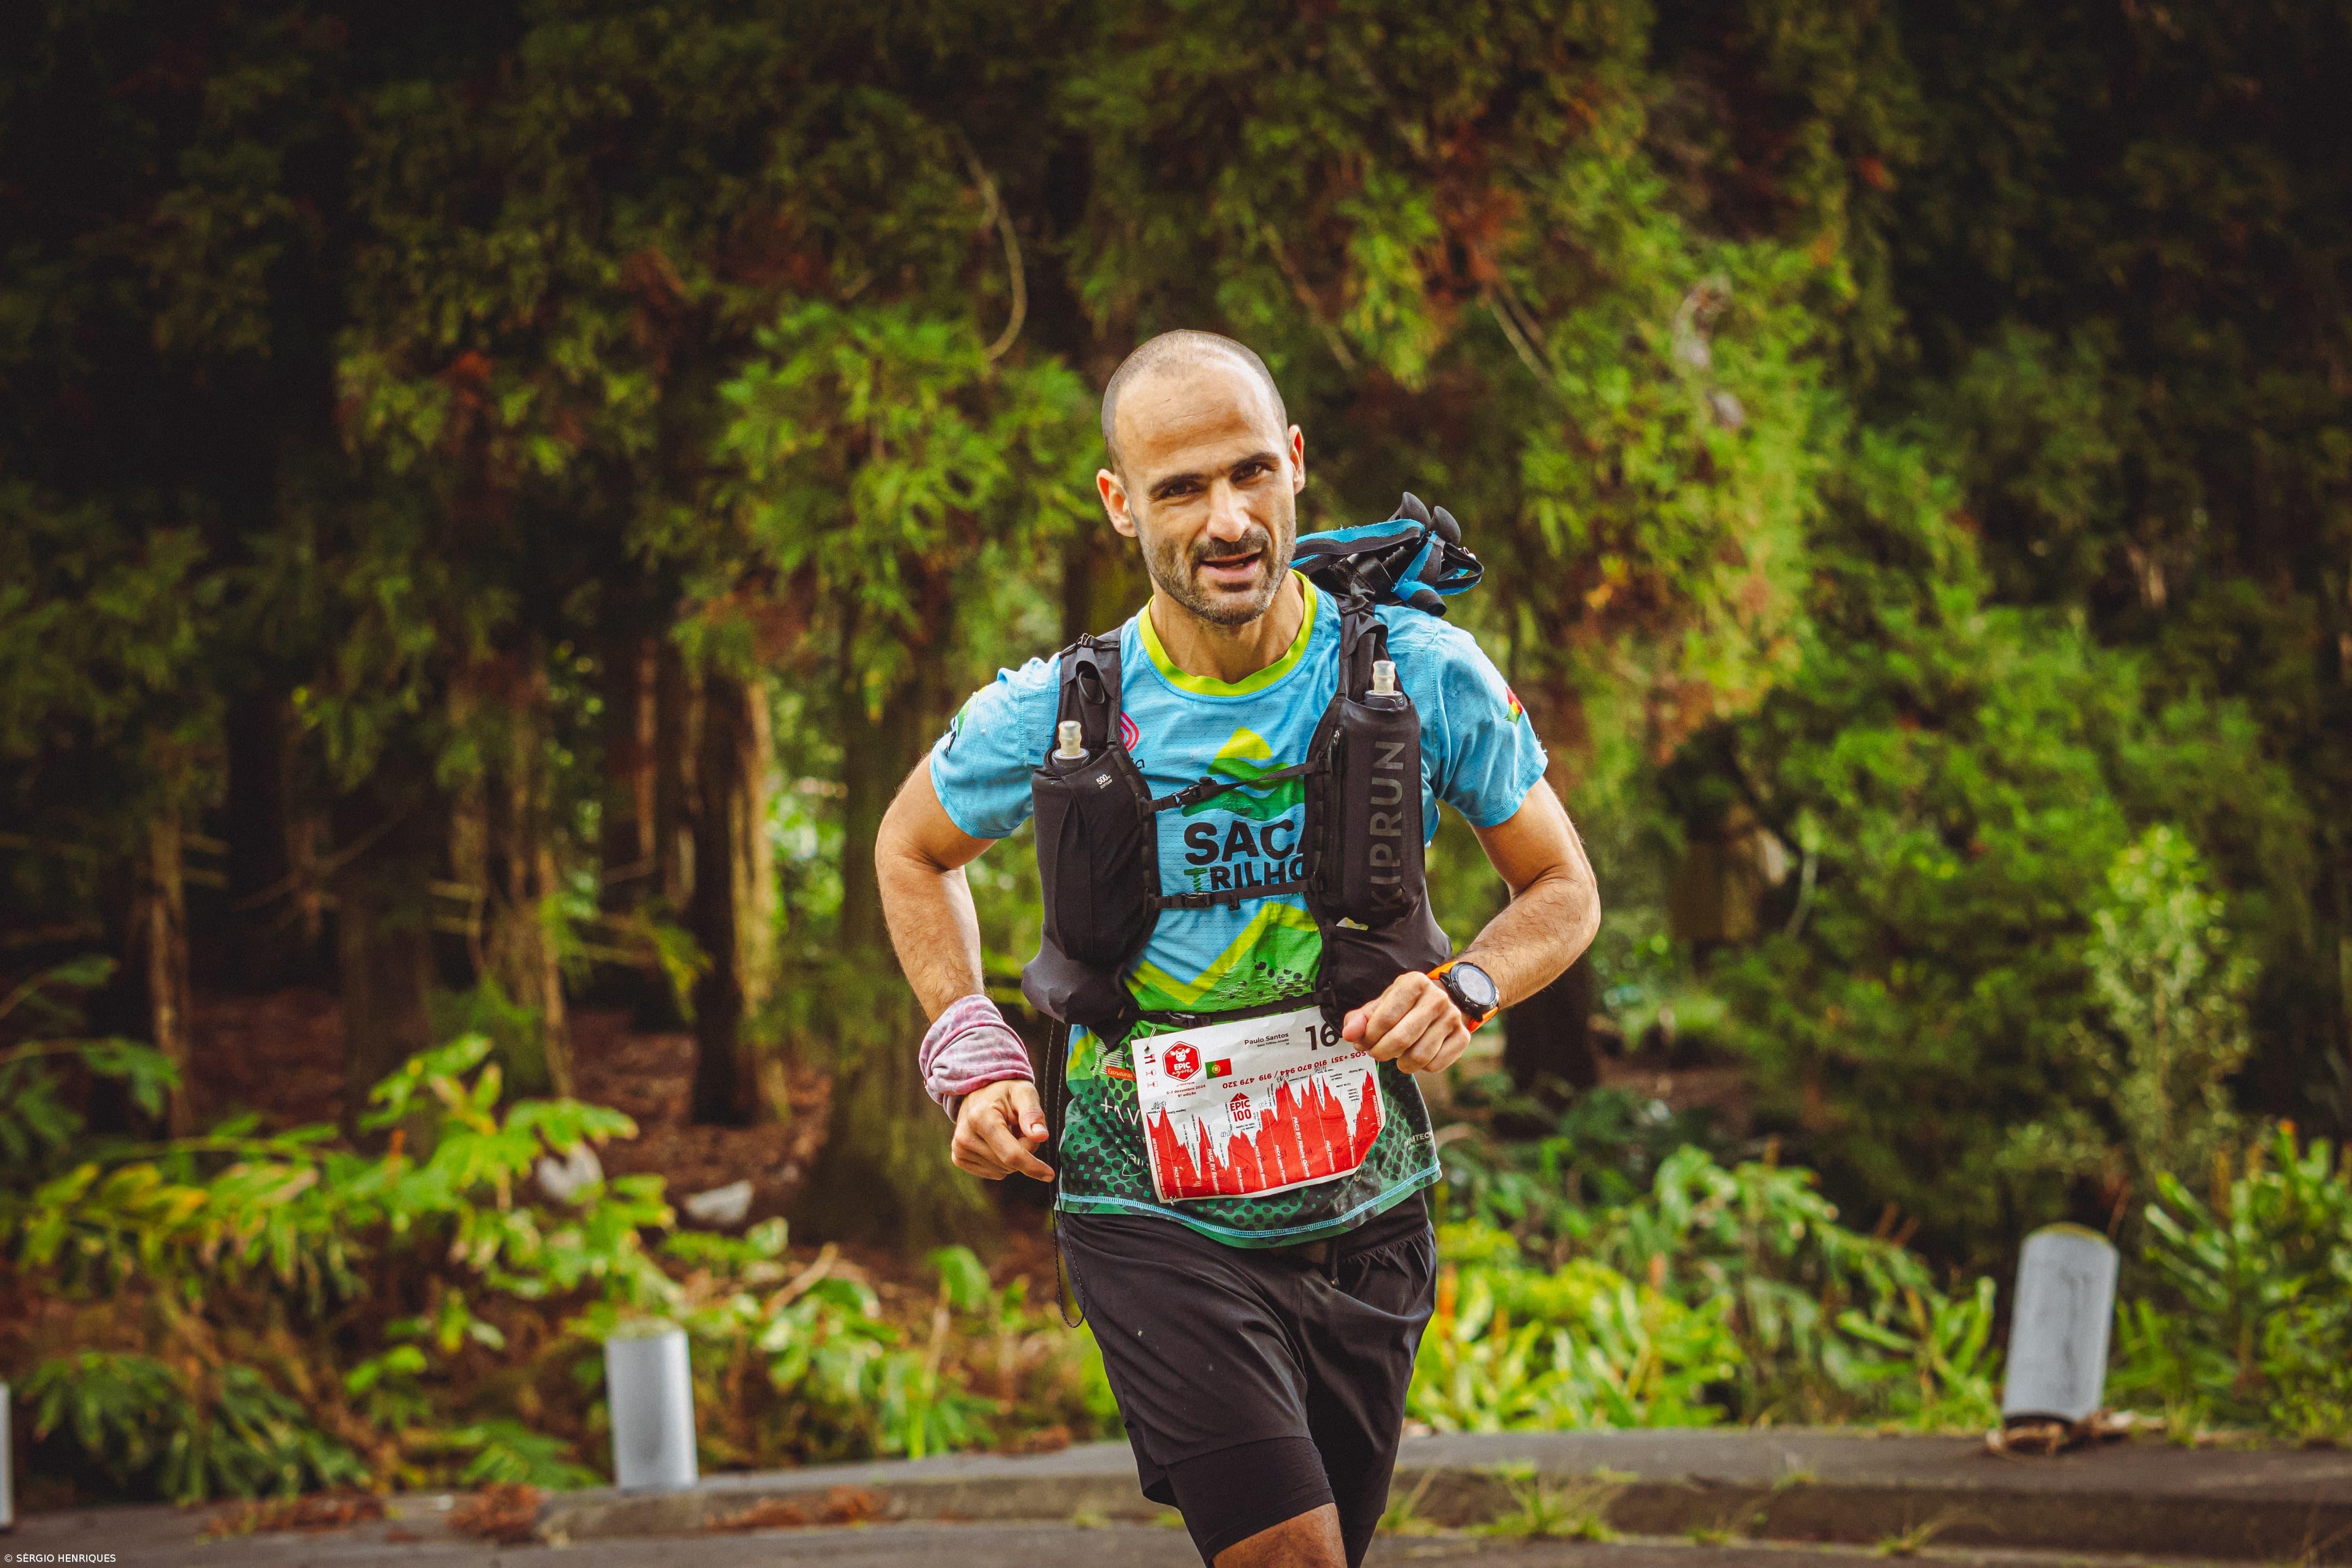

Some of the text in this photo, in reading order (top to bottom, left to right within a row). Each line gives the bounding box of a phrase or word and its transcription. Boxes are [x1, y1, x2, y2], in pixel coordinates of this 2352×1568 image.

[1369, 742, 1405, 911] KIPRUN
[1244, 1032, 1289, 1045] Paulo Santos
[1331, 1055, 1347, 1064] +351
[1351, 1051, 1366, 1059] SOS
[1173, 1062, 1191, 1071] EPIC
[1315, 1059, 1327, 1068] 910
[1107, 1068, 1133, 1078] Estruturas
[1281, 1068, 1295, 1077] 944
[1230, 1100, 1251, 1111] EPIC
[1233, 1109, 1252, 1122] 100
[1296, 1131, 1301, 1140] BV
